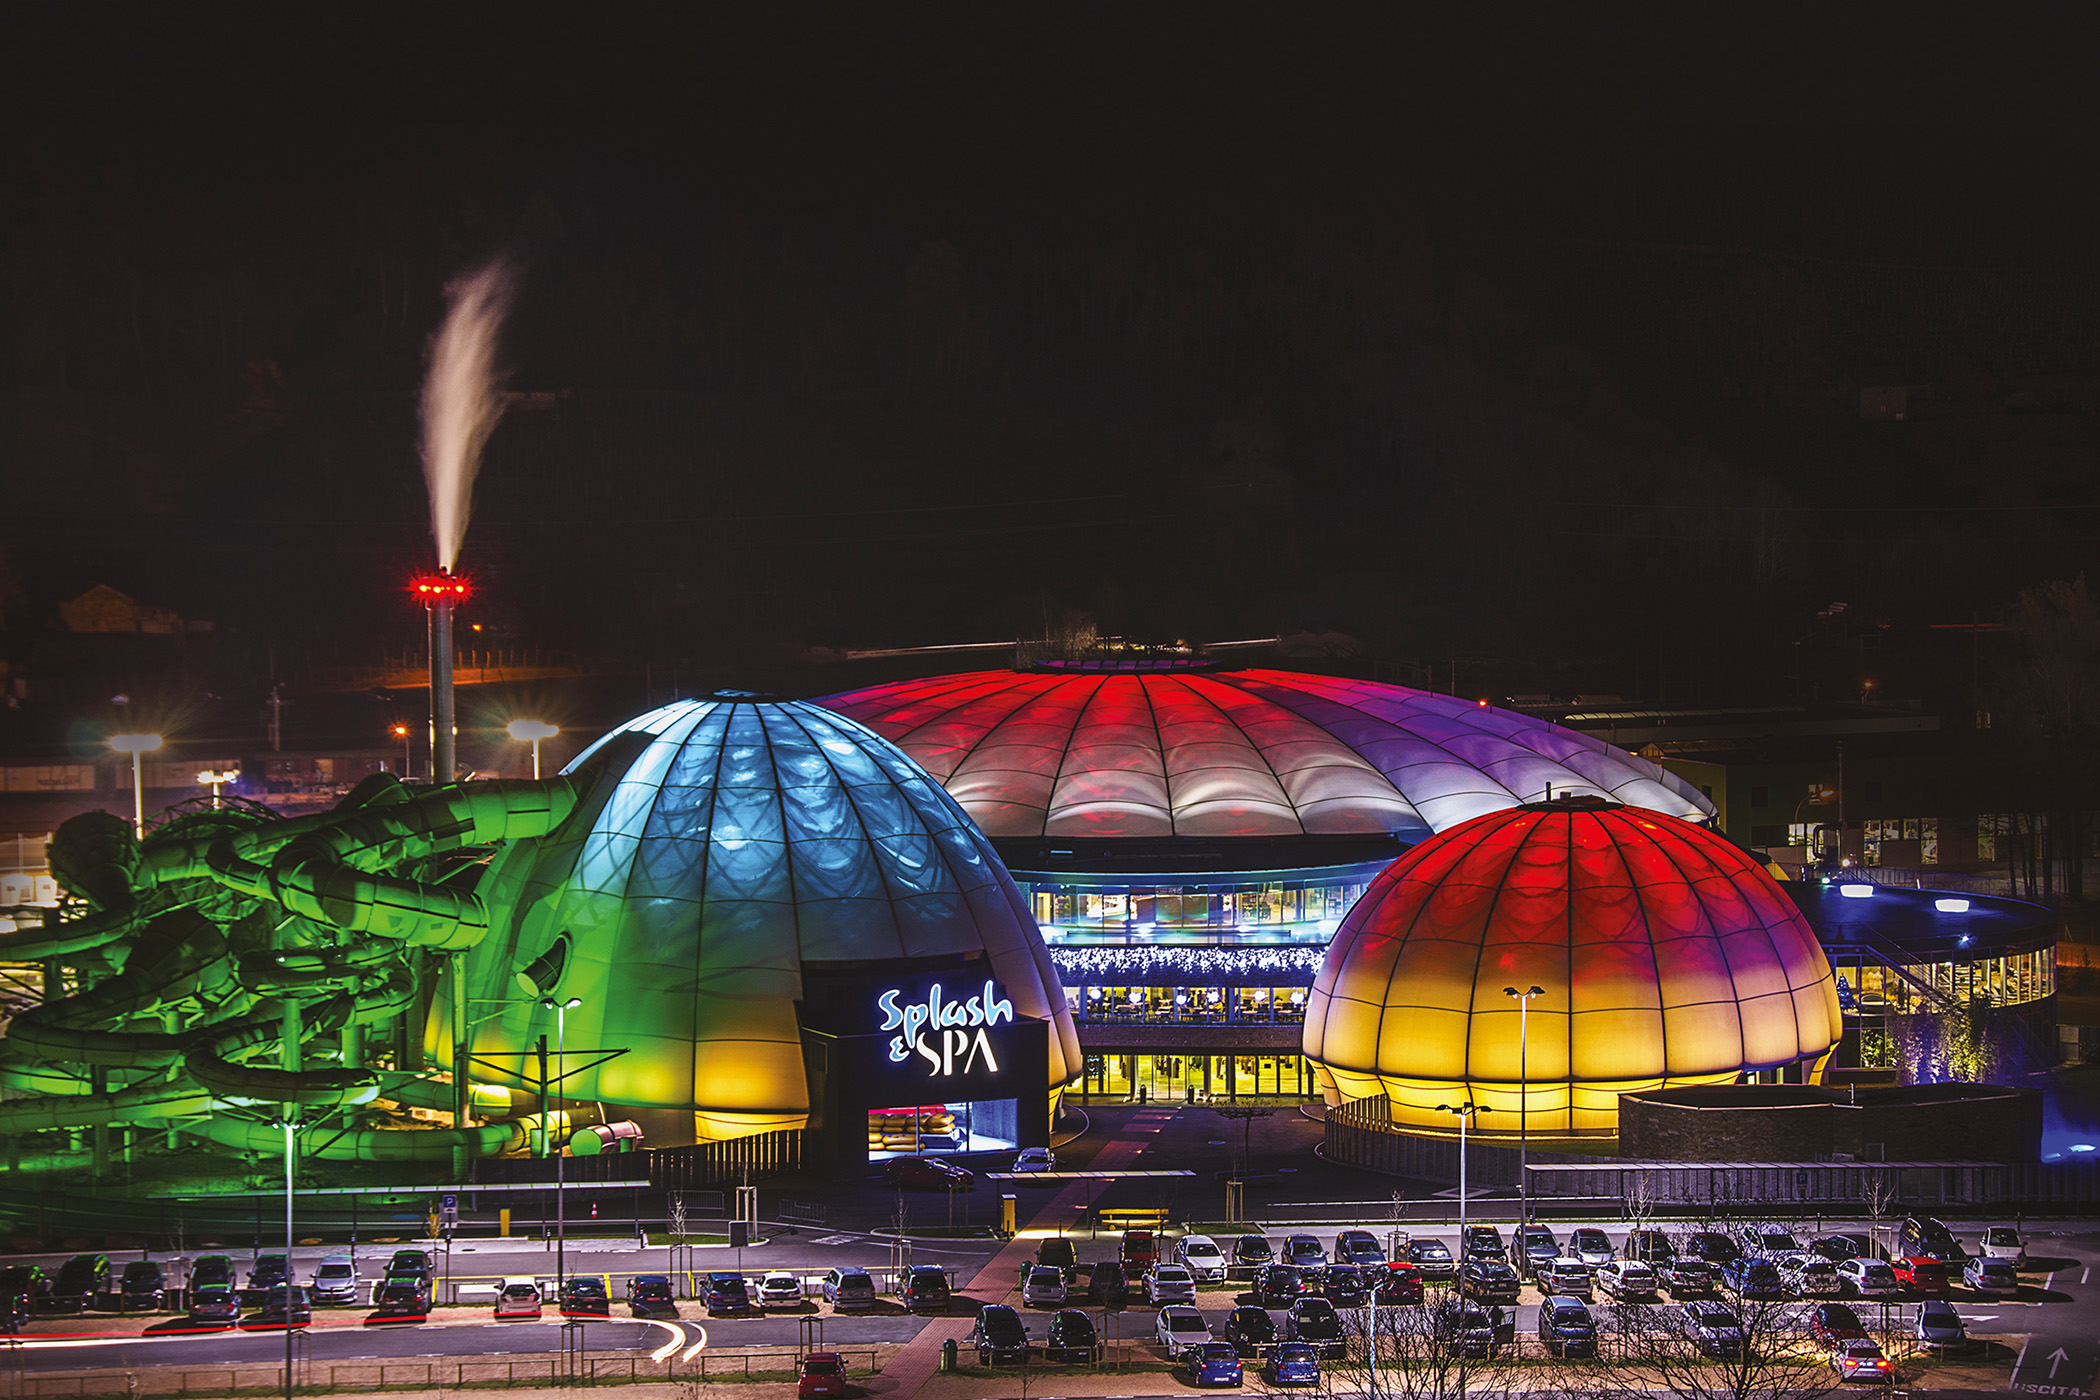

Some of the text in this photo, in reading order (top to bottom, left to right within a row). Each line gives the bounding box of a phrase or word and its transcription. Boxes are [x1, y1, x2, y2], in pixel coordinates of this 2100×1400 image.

[878, 979, 1013, 1049] Splash
[889, 1027, 999, 1077] & SPA
